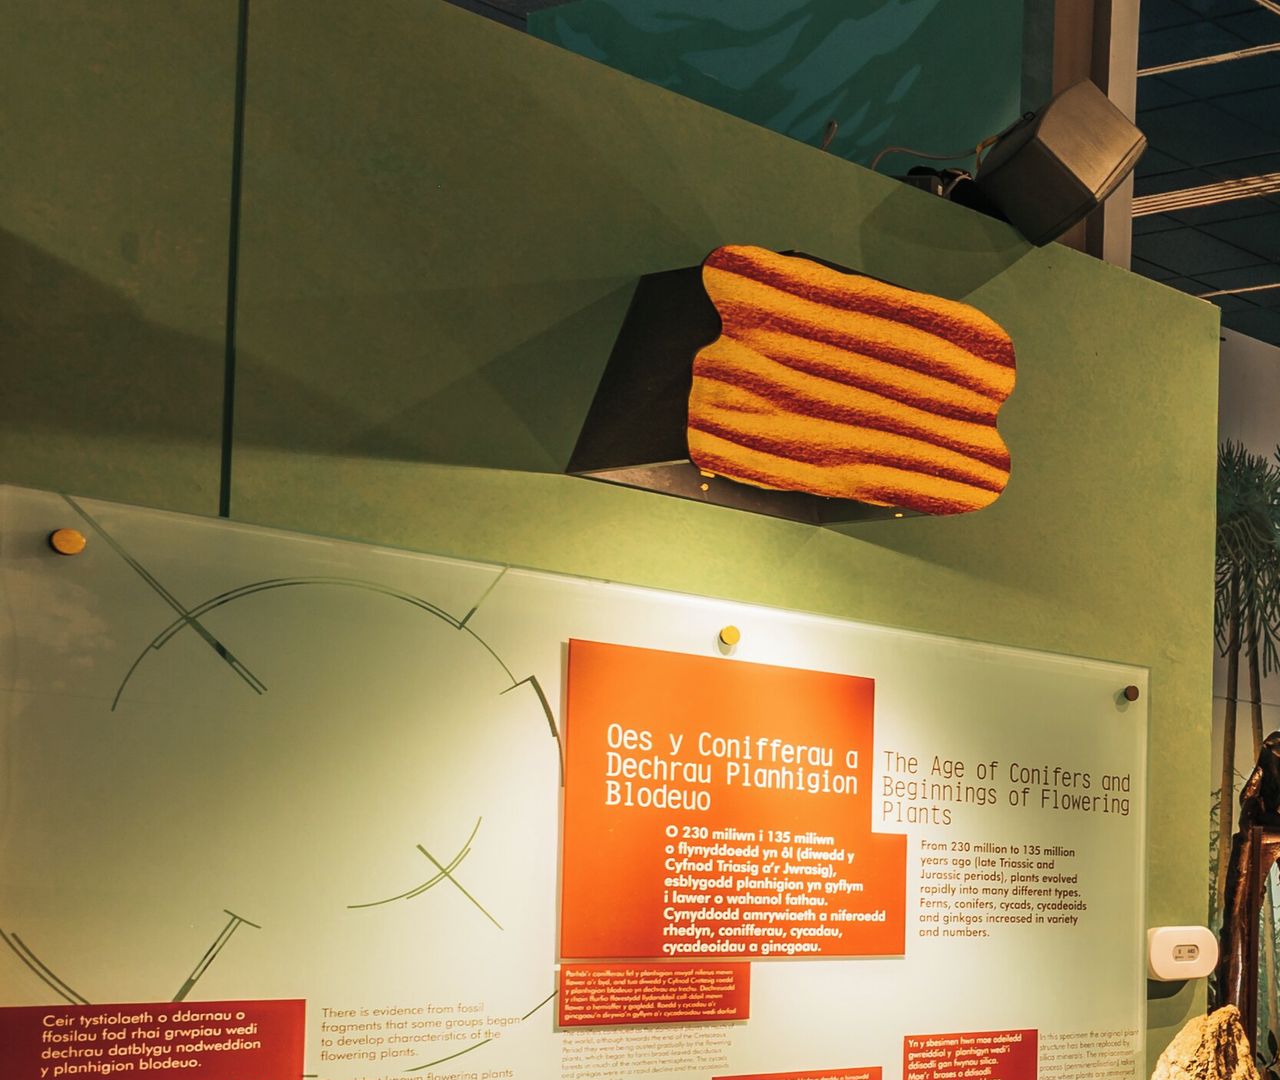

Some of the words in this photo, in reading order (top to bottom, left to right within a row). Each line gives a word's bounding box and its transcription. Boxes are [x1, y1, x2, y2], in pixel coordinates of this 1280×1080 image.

[607, 724, 652, 751] Oes
[669, 734, 682, 756] y
[698, 732, 832, 766] Conifferau
[845, 749, 858, 768] a
[606, 753, 711, 783] Dechrau
[727, 762, 857, 796] Planhigion
[884, 751, 918, 775] The
[931, 756, 964, 780] Age
[976, 762, 998, 781] of
[1010, 762, 1090, 788] Conifers
[1101, 772, 1130, 792] and
[606, 781, 710, 810] Blodeuo
[883, 776, 996, 805] Beginnings
[1009, 787, 1029, 806] of
[1041, 787, 1129, 816] Flowering
[883, 801, 951, 825] Plants
[665, 825, 678, 837] O
[682, 826, 708, 839] 230
[712, 827, 755, 841] miliwn
[759, 828, 763, 842] i
[768, 830, 790, 843] 135
[794, 831, 834, 845] miliwn
[665, 845, 674, 854] o
[678, 841, 759, 858] flynyddoedd
[762, 848, 778, 861] yn
[781, 845, 793, 858] ôl
[796, 845, 844, 862] (diwedd
[847, 851, 854, 864] y
[921, 840, 947, 851] From
[951, 842, 970, 852] 230
[973, 842, 1007, 854] million
[1010, 845, 1019, 854] to
[1024, 845, 1040, 855] 135
[1043, 845, 1075, 856] million
[665, 857, 713, 874] Cyfnod
[718, 859, 758, 876] Triasig
[762, 860, 780, 873] a'r
[782, 862, 836, 878] Jwrasig),
[920, 857, 948, 868] years
[951, 858, 971, 869] ago
[974, 855, 996, 870] (late
[1000, 857, 1033, 868] Triassic
[1036, 858, 1054, 869] and
[664, 874, 732, 891] esblygodd
[736, 875, 804, 892] planhigion
[807, 881, 821, 893] yn
[825, 877, 863, 894] gyflym
[920, 868, 960, 880] Jurassic
[964, 869, 1007, 884] periods),
[1010, 870, 1039, 885] plants
[1042, 872, 1077, 883] evolved
[664, 890, 668, 903] i
[672, 890, 711, 903] lawer
[714, 894, 723, 903] o
[726, 891, 782, 904] wahanol
[785, 892, 827, 905] fathau.
[920, 883, 956, 898] rapidly
[959, 883, 978, 894] into
[982, 888, 1009, 899] many
[1012, 884, 1052, 896] different
[1054, 887, 1080, 900] types.
[920, 898, 950, 910] Ferns,
[954, 897, 996, 911] conifers,
[999, 898, 1033, 912] cycads,
[1036, 899, 1087, 913] cycadeoids
[663, 907, 739, 923] Cynyddodd
[743, 908, 816, 924] amrywiaeth
[819, 912, 827, 921] a
[830, 908, 885, 921] niferoedd
[919, 911, 939, 922] and
[942, 911, 982, 926] ginkgos
[986, 911, 1032, 923] increased
[1035, 912, 1044, 923] in
[1047, 912, 1078, 926] variety
[663, 922, 714, 939] rhedyn,
[718, 922, 786, 938] conifferau,
[790, 923, 842, 939] cycadau,
[919, 925, 939, 936] and
[942, 926, 989, 937] numbers.
[662, 939, 745, 955] cycadeoidau
[749, 943, 757, 952] a
[761, 939, 821, 955] gincgoau.
[43, 1014, 74, 1027] Ceir
[80, 1011, 152, 1030] tystiolaeth
[157, 1014, 167, 1022] o
[172, 1009, 231, 1022] ddarnau
[236, 1011, 245, 1019] o
[322, 1007, 356, 1018] There
[360, 1006, 369, 1016] is
[372, 1004, 424, 1016] evidence
[427, 1003, 454, 1013] from
[457, 1001, 484, 1012] fossil
[42, 1029, 96, 1042] ffosilau
[102, 1027, 126, 1040] fod
[131, 1026, 159, 1039] rhai
[164, 1024, 221, 1042] grwpiau
[225, 1022, 257, 1035] wedi
[321, 1021, 382, 1035] fragments
[385, 1018, 407, 1029] that
[411, 1020, 442, 1028] some
[445, 1018, 483, 1030] groups
[486, 1014, 520, 1028] began
[321, 1038, 333, 1047] to
[337, 1034, 384, 1047] develop
[387, 1030, 467, 1043] characteristics
[470, 1029, 481, 1039] of
[484, 1028, 501, 1039] the
[41, 1045, 103, 1059] dechrau
[108, 1042, 171, 1058] datblygu
[176, 1037, 261, 1052] nodweddion
[321, 1048, 376, 1062] flowering
[40, 1067, 48, 1079] y
[54, 1059, 134, 1079] planhigion
[139, 1056, 201, 1070] blodeuo.
